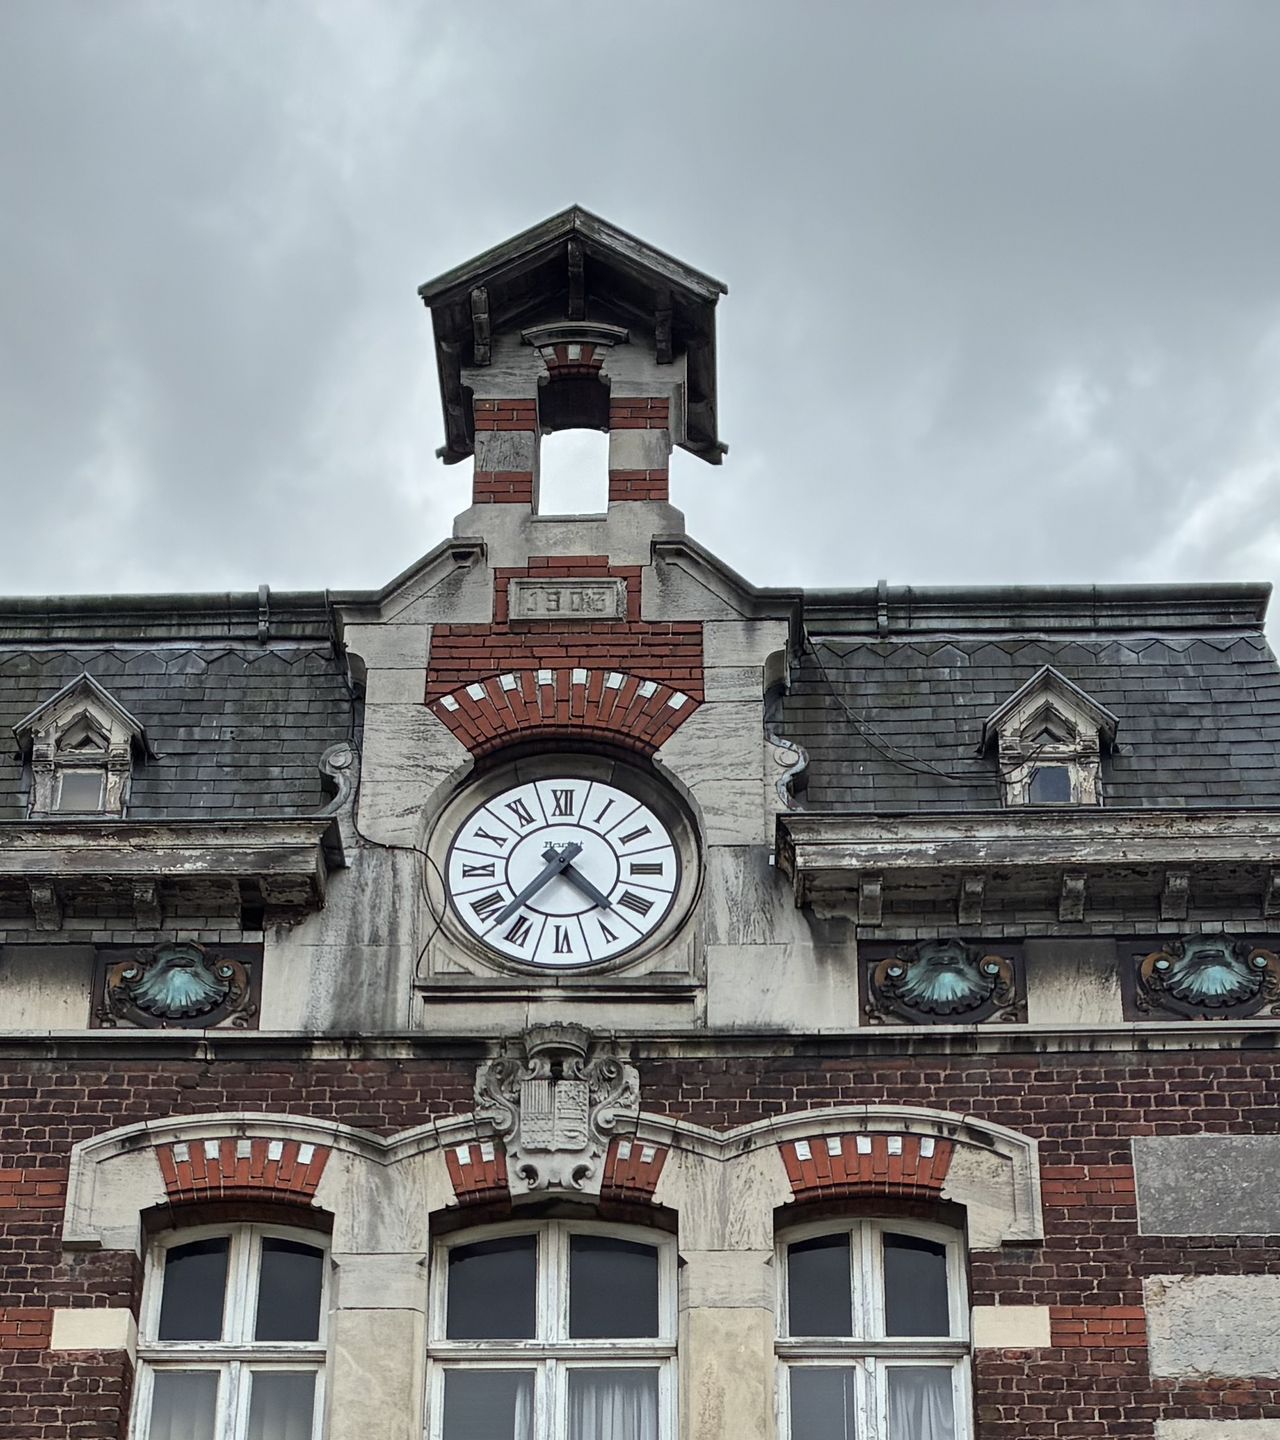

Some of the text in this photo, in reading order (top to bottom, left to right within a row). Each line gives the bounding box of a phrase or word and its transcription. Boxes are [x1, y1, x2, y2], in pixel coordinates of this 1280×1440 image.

[504, 797, 537, 828] XI
[551, 788, 575, 816] XII
[593, 798, 616, 824] I
[473, 826, 508, 848] X
[618, 825, 652, 846] II
[462, 862, 496, 879] IX
[629, 862, 663, 876] III
[469, 889, 508, 924] VIII
[617, 889, 655, 918] IIII
[502, 914, 535, 948] VII
[553, 924, 573, 953] VI
[596, 918, 619, 944] V
